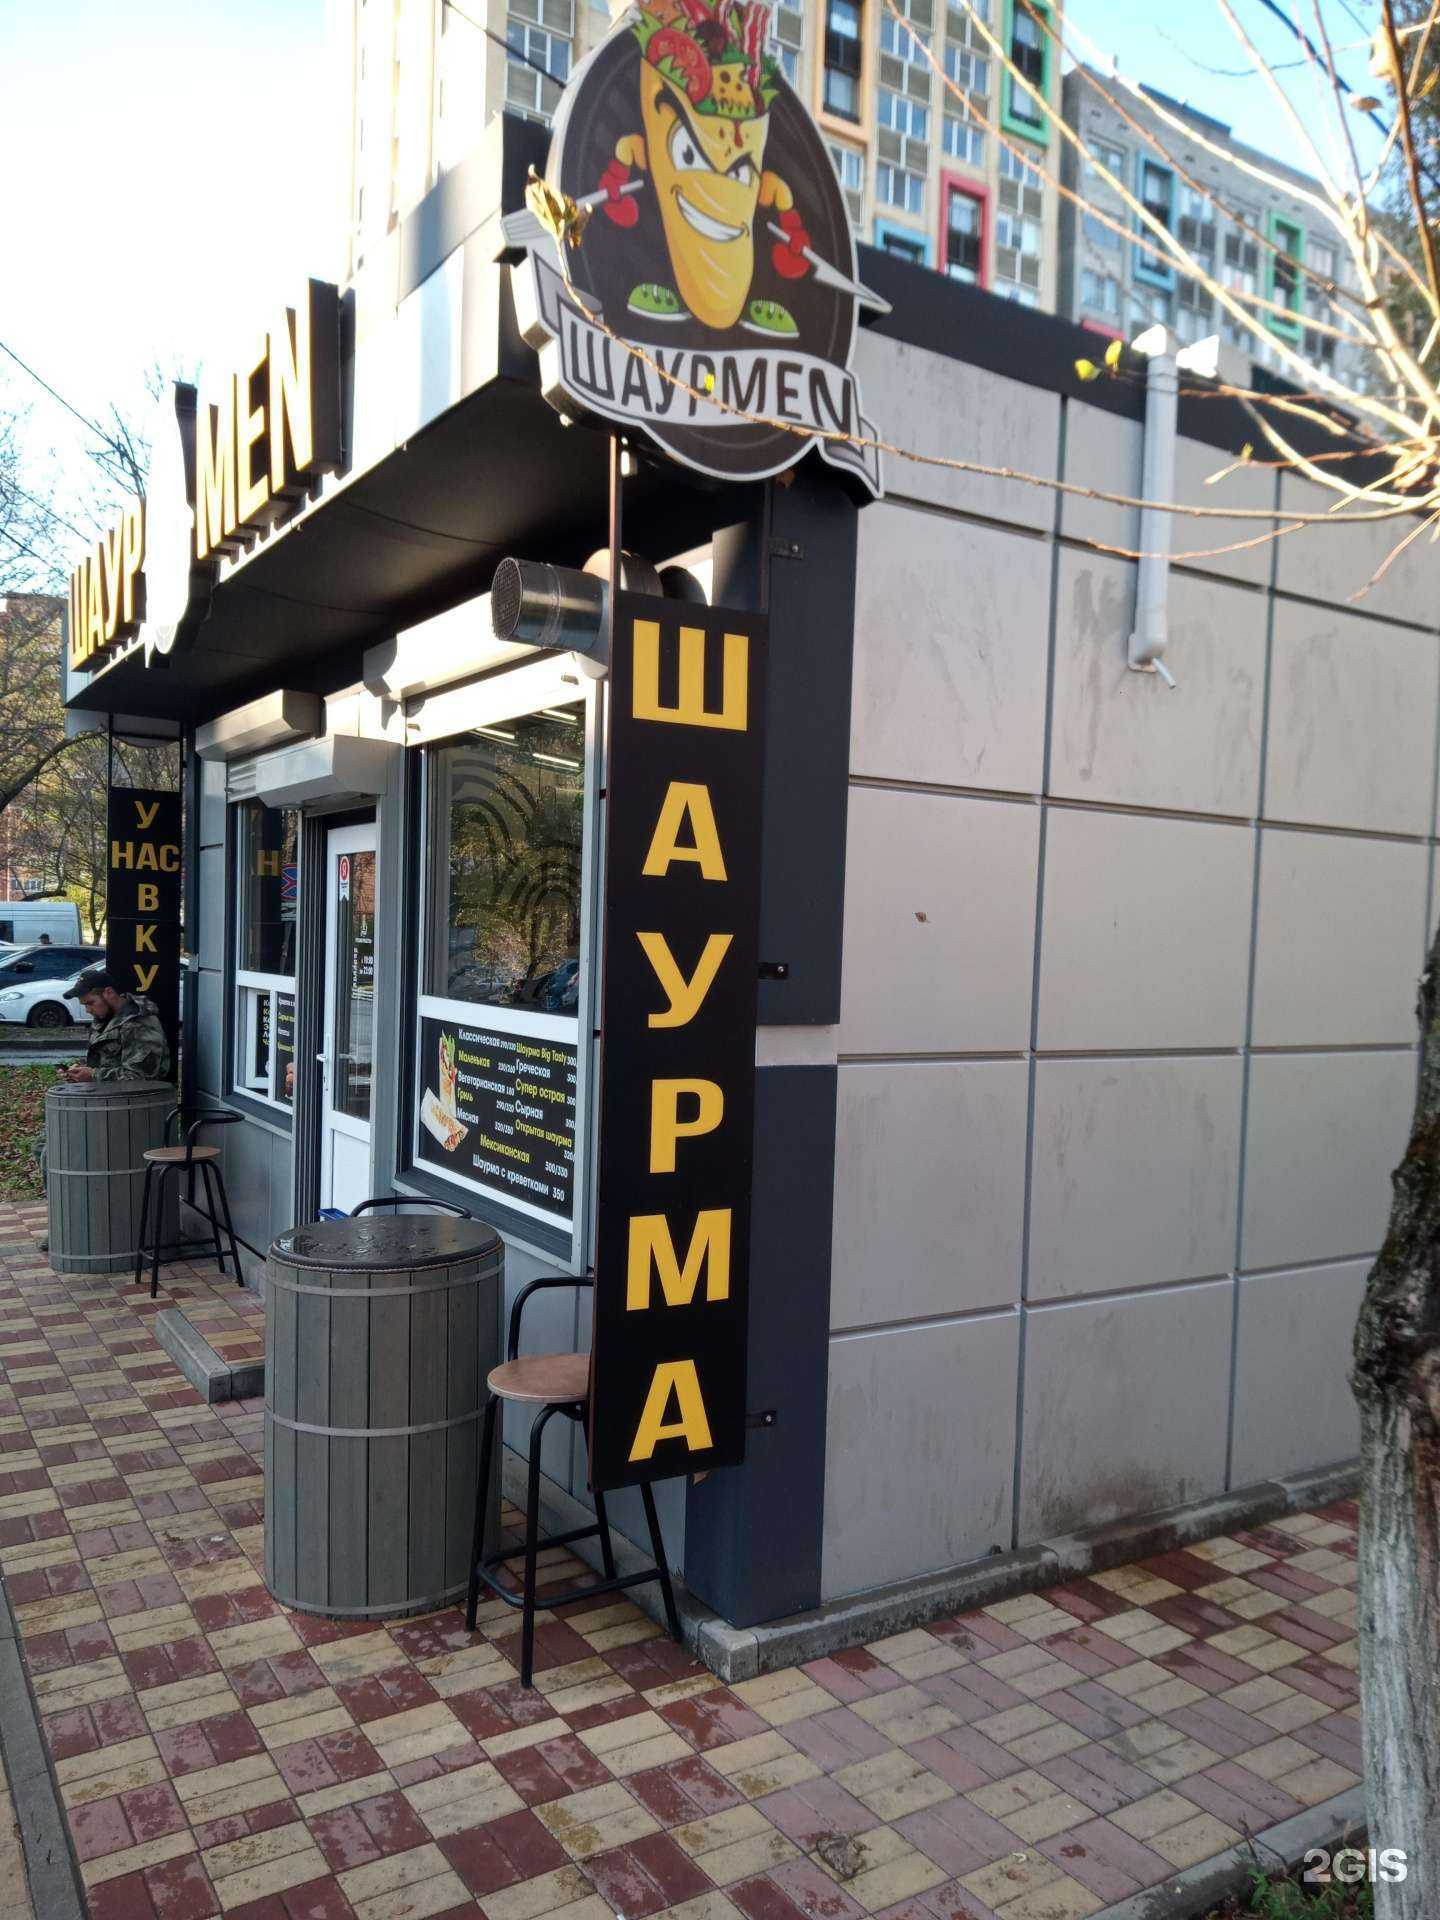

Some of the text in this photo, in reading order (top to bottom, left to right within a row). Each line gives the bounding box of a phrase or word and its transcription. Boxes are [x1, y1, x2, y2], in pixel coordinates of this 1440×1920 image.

[134, 800, 160, 829] У
[112, 840, 180, 873] НАС
[459, 1028, 500, 1047] Классическая
[626, 619, 749, 1462] ШАУРМА
[459, 1050, 490, 1067] Маленькая
[541, 1047, 551, 1062] Big
[552, 1050, 567, 1066] Tasty
[516, 1058, 551, 1078] Греческая
[458, 1087, 473, 1102] Гриль
[515, 1078, 538, 1098] Супер
[539, 1088, 565, 1103] острая
[457, 1106, 479, 1124] Мясная
[515, 1099, 543, 1119] Сырная
[515, 1119, 545, 1138] Открытая
[480, 1133, 530, 1163] Мексиканская
[473, 1153, 500, 1175] Шаурма
[507, 1170, 549, 1196] креветками
[552, 1186, 565, 1202] 350
